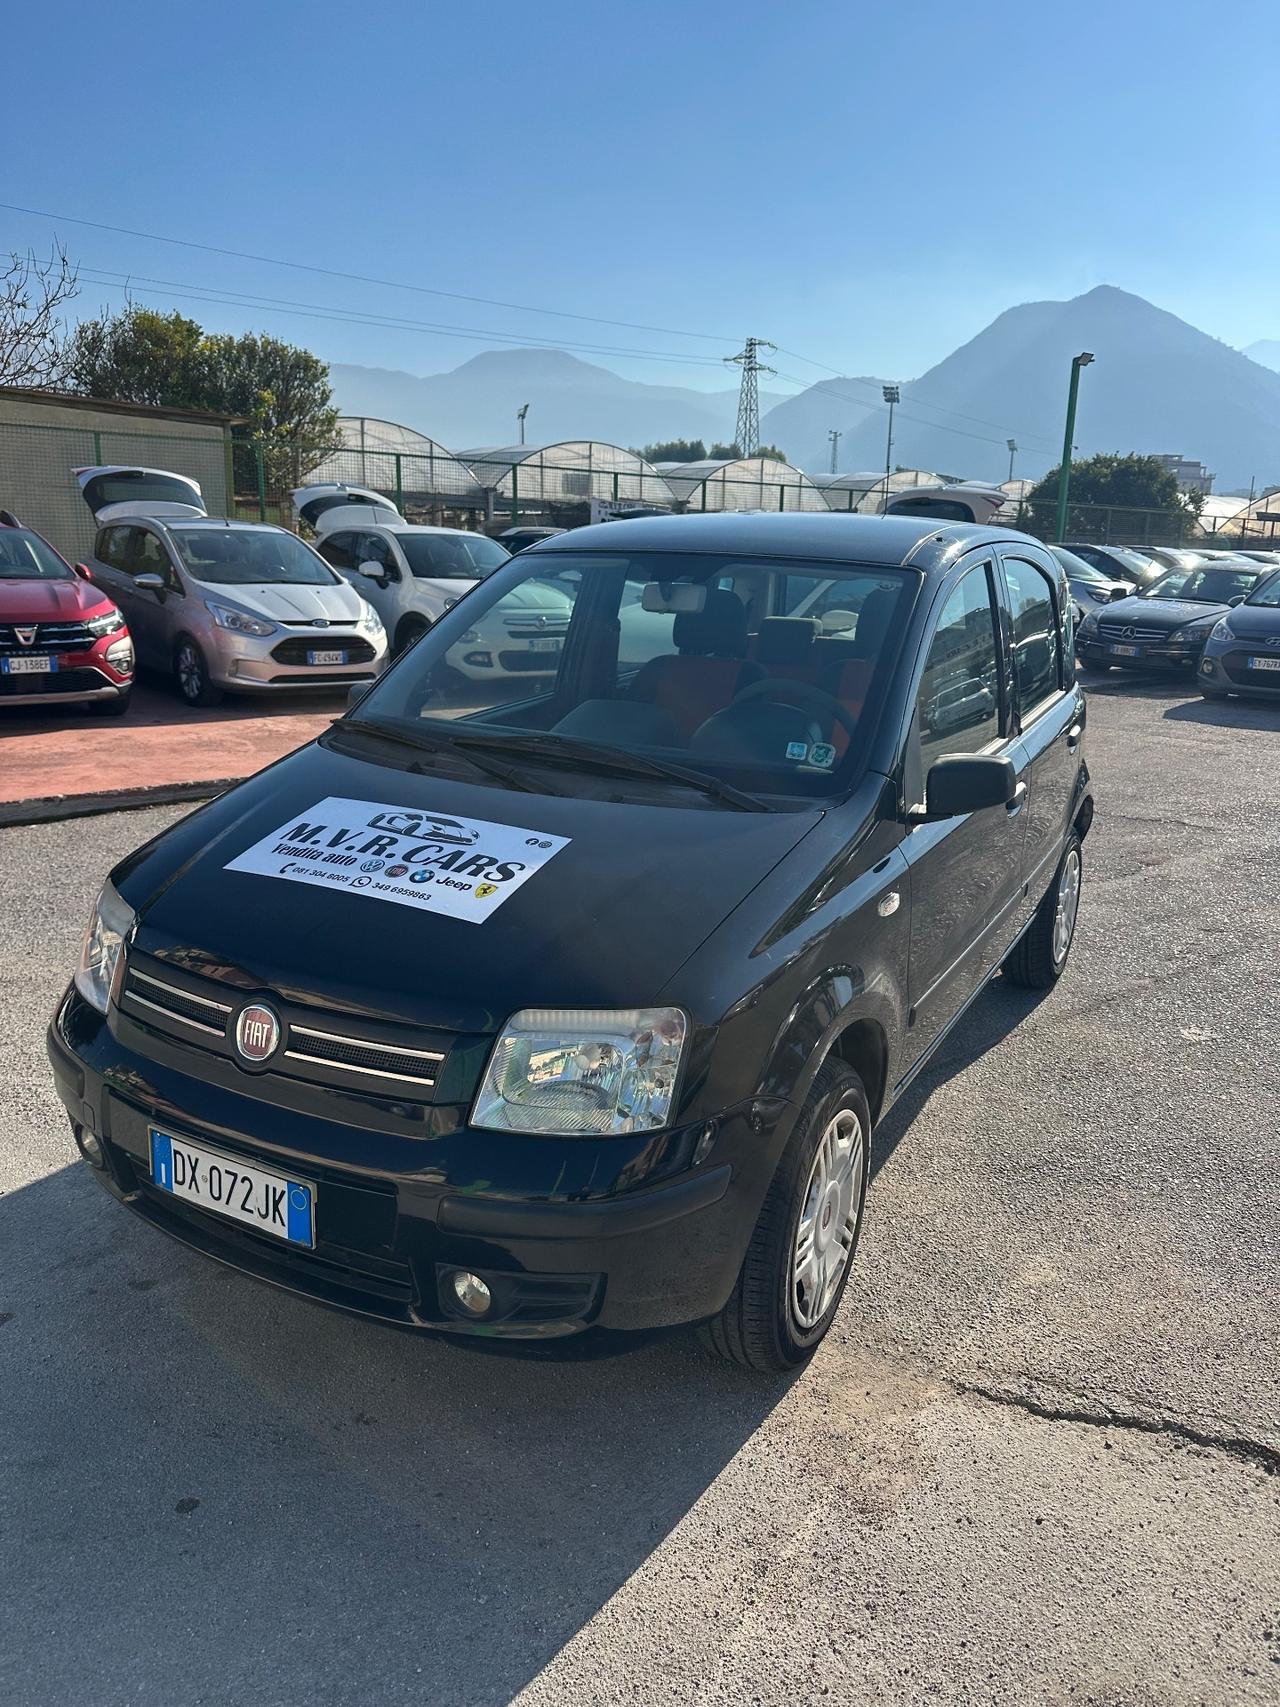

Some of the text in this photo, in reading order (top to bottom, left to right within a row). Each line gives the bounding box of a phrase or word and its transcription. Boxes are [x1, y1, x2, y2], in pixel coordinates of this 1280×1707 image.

[271, 843, 358, 867] Vendita auto
[292, 866, 351, 883] 081 304 6005
[371, 882, 432, 901] 349 6959863
[435, 877, 473, 892] Jeep
[244, 1019, 271, 1048] FIAT
